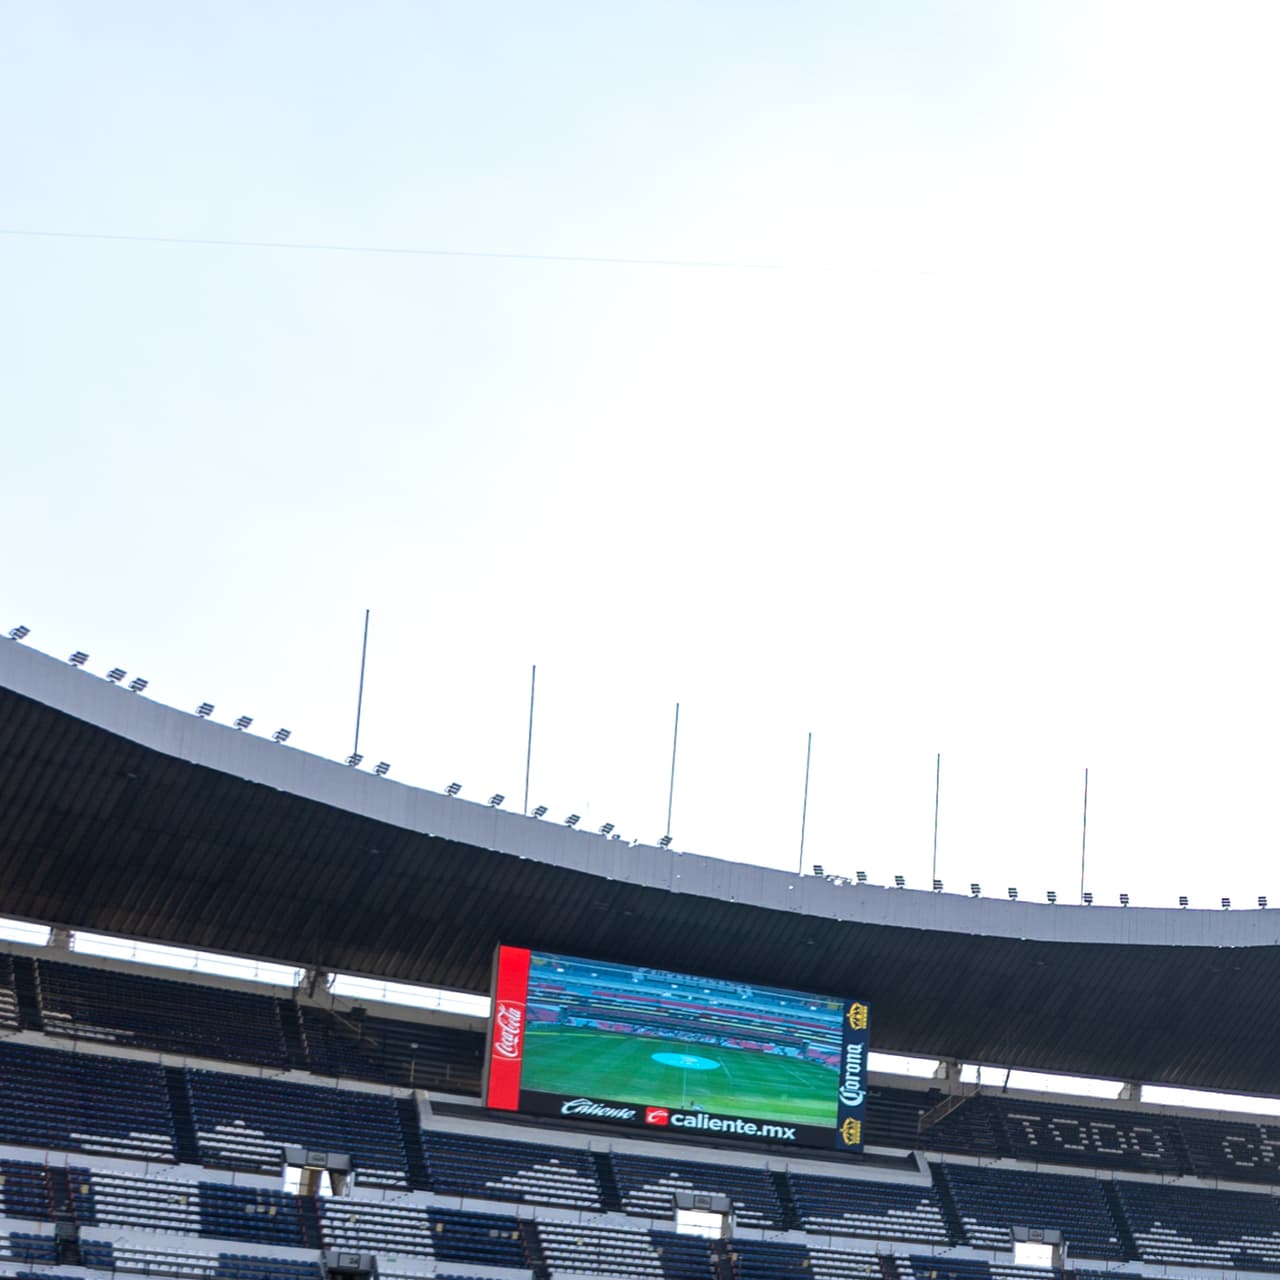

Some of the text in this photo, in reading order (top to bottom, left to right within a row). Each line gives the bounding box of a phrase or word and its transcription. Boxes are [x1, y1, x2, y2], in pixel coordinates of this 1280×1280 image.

[494, 1004, 522, 1059] Coca-Cola
[839, 1043, 864, 1107] Corona
[561, 1098, 636, 1121] Caliente
[671, 1113, 796, 1141] caliente.mx
[1007, 1113, 1165, 1158] TODO
